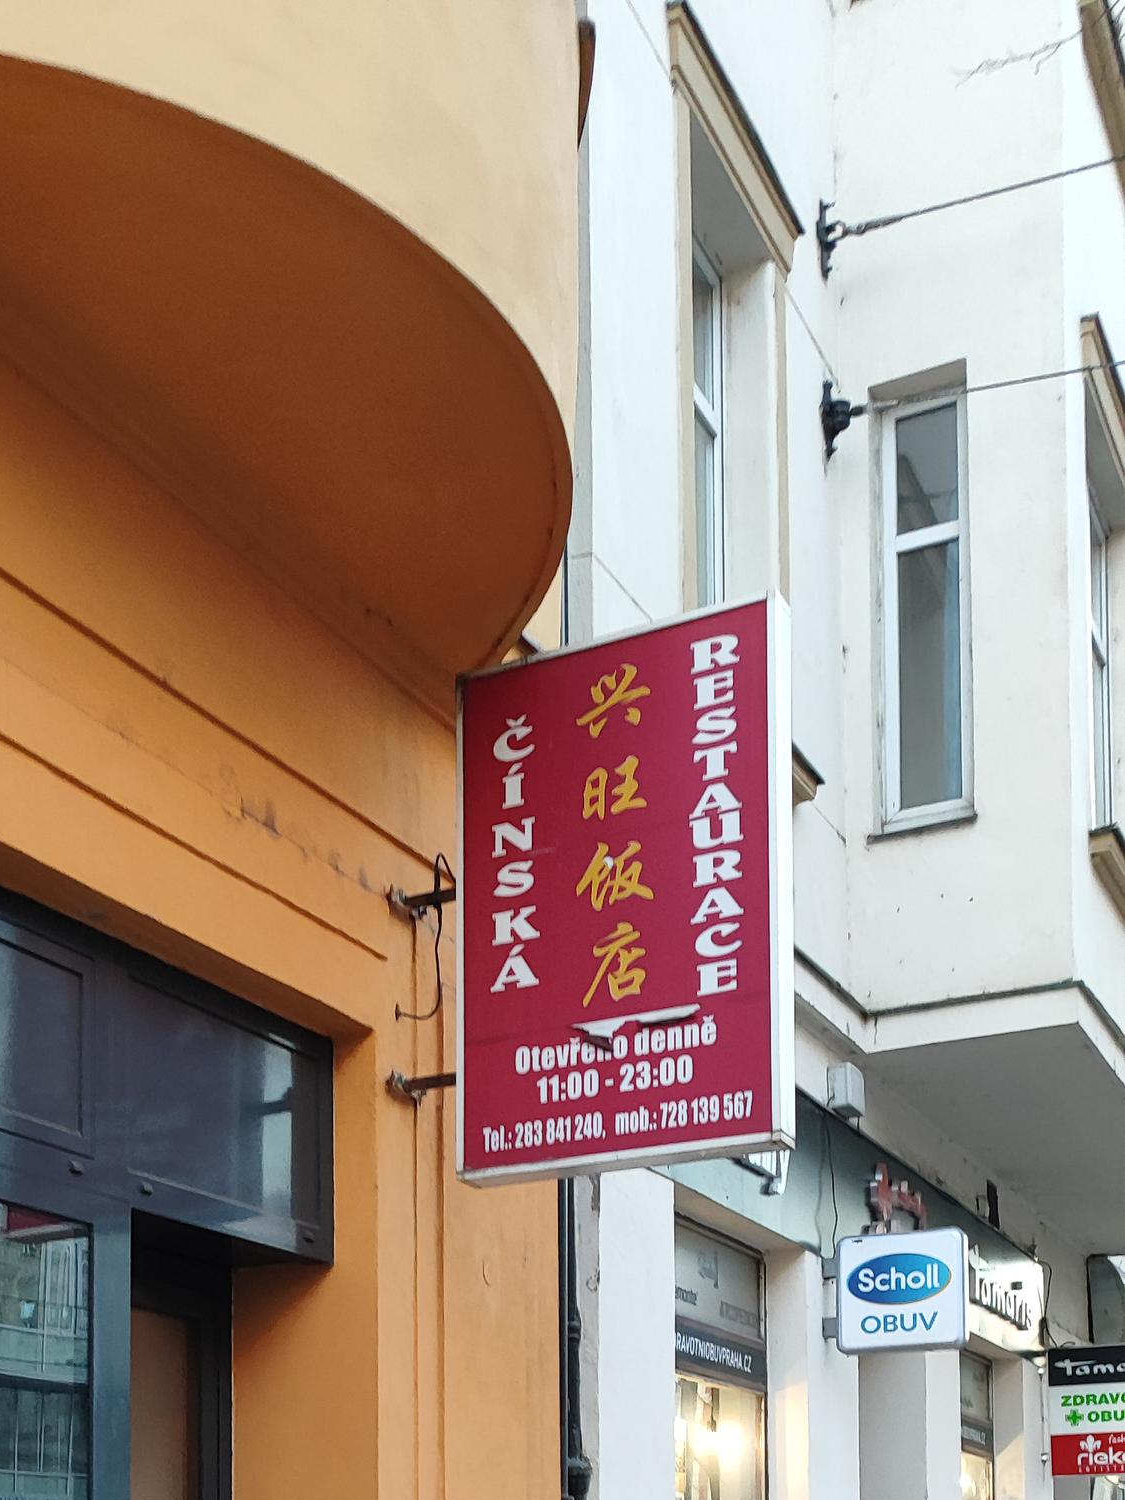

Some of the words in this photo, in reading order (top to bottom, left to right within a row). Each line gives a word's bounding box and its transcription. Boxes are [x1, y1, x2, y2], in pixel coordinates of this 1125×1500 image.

[575, 662, 654, 1008] 兴旺饭店
[688, 633, 744, 997] RESTAURACE
[490, 713, 540, 994] ČÍNSKÁ
[634, 1015, 717, 1057] denně
[536, 1068, 599, 1104] 11:00
[619, 1054, 694, 1093] 23:00
[482, 1126, 513, 1153] Tel.:
[514, 1121, 543, 1149] 283
[546, 1115, 572, 1145] 841
[574, 1111, 606, 1141] 240,
[615, 1105, 657, 1136] mob.:
[659, 1099, 688, 1130] 728
[691, 1094, 720, 1125] 139
[723, 1089, 753, 1121] 567
[857, 1262, 940, 1293] Scholl
[860, 1311, 939, 1334] OBUV
